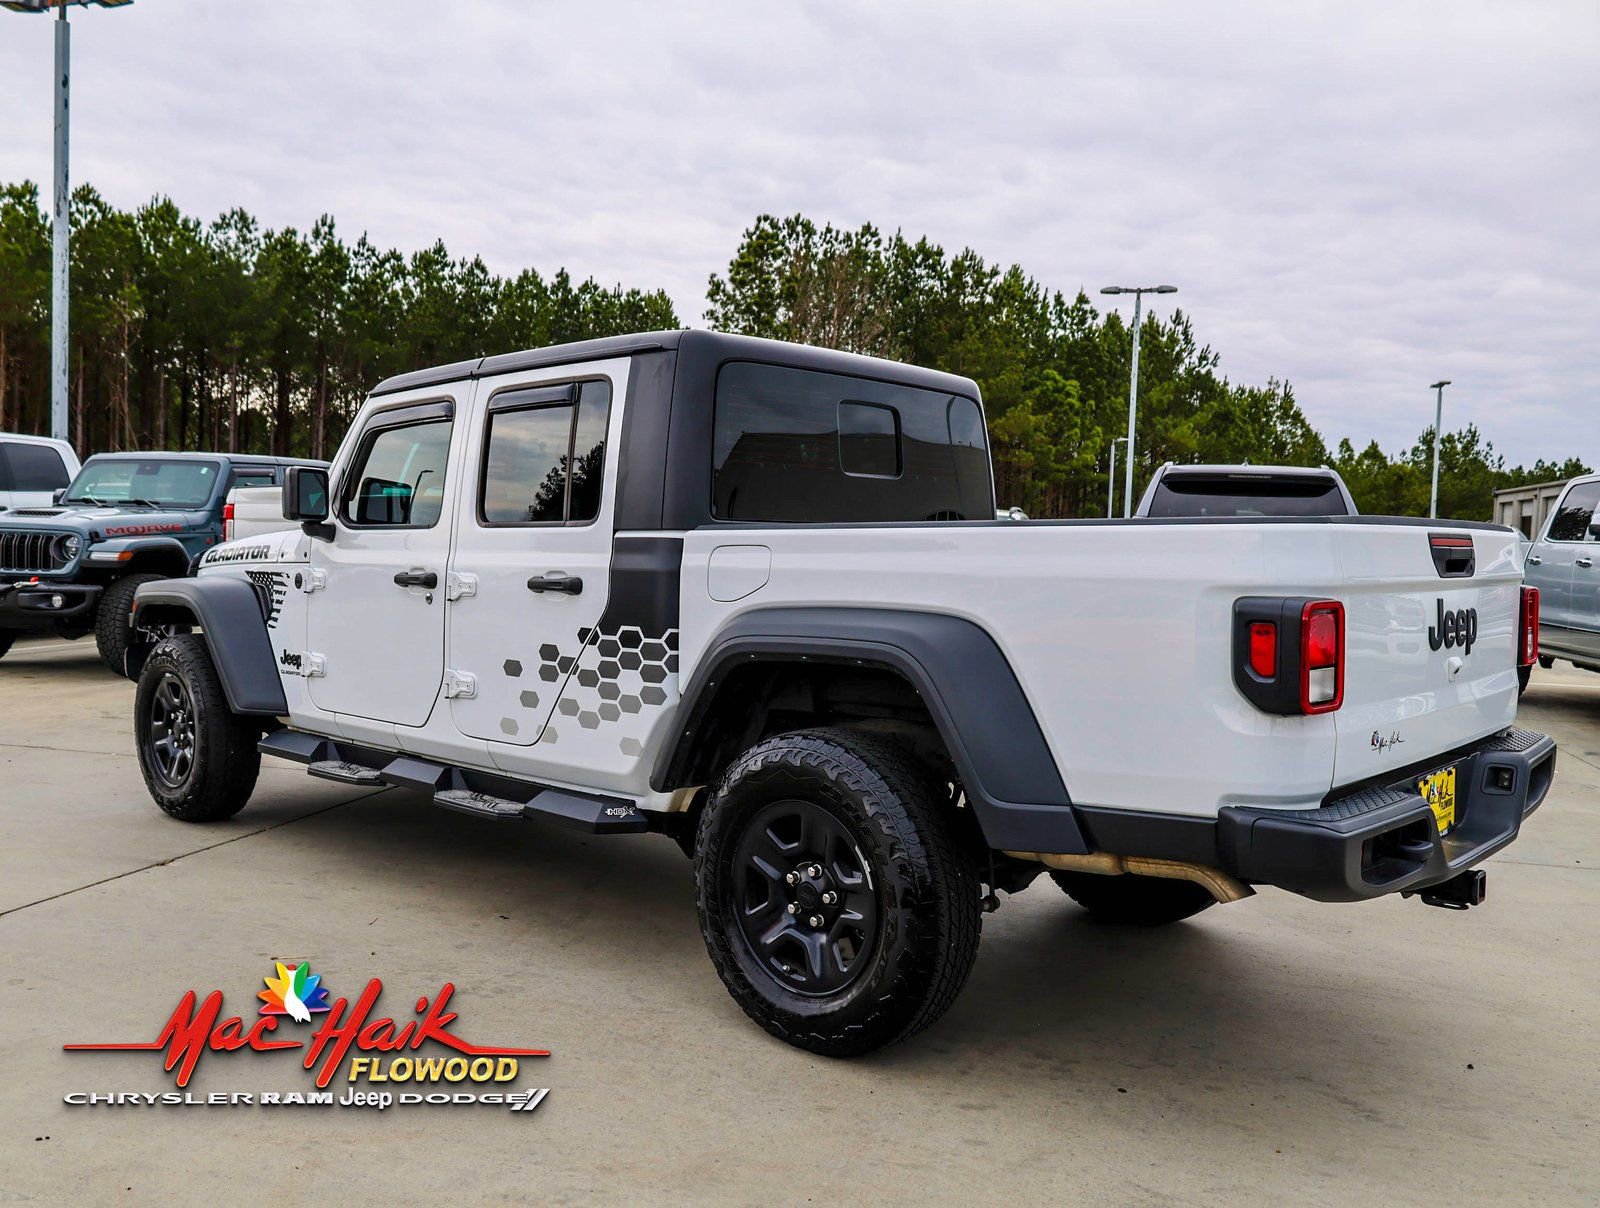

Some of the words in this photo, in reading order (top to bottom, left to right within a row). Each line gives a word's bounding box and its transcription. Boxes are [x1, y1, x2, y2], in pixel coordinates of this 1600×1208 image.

[104, 523, 183, 536] MOJAVE
[205, 544, 272, 564] GLADIATOR
[1428, 598, 1478, 656] Jeep
[280, 649, 302, 670] Jeep
